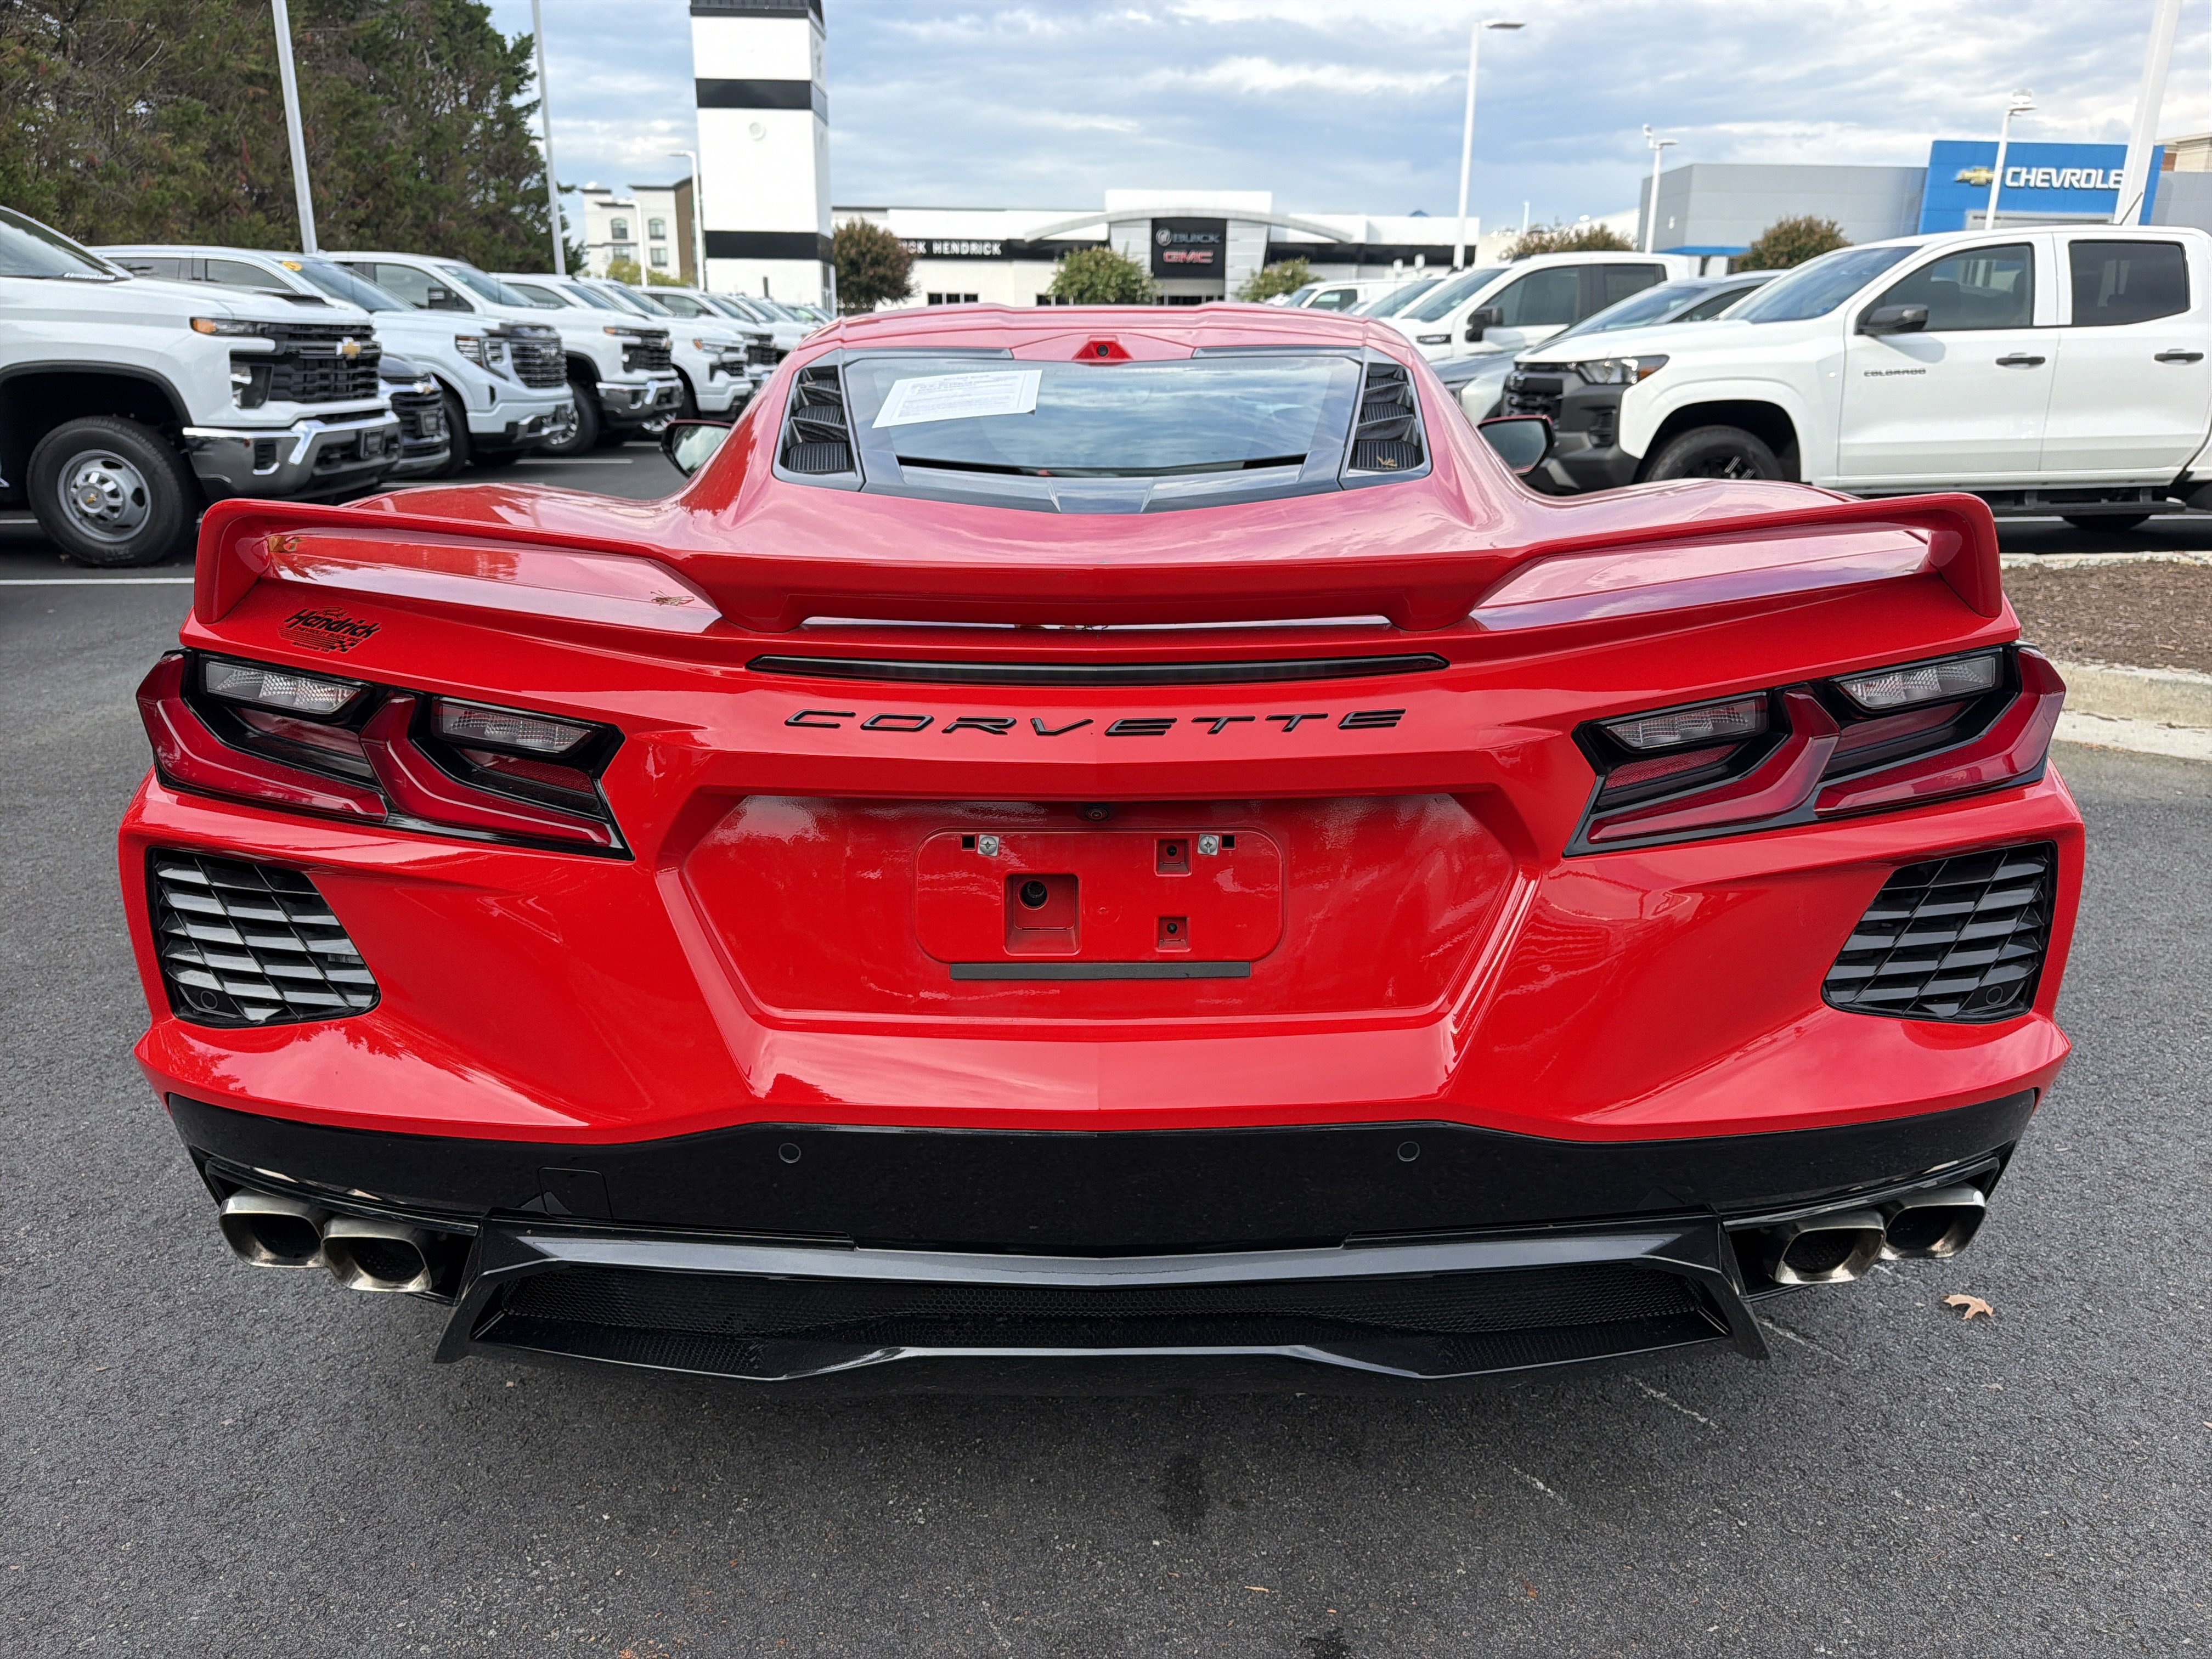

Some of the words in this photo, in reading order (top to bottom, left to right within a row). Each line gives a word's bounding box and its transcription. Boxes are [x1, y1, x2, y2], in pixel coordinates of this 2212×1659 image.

[2005, 167, 2124, 189] CHEVROLE
[1173, 232, 1221, 243] BUICK
[899, 240, 927, 254] ICK
[933, 240, 1002, 255] HENDRICK
[1163, 250, 1214, 263] GMC
[284, 608, 381, 638] Hendrick
[783, 708, 1407, 736] CORVETTE
